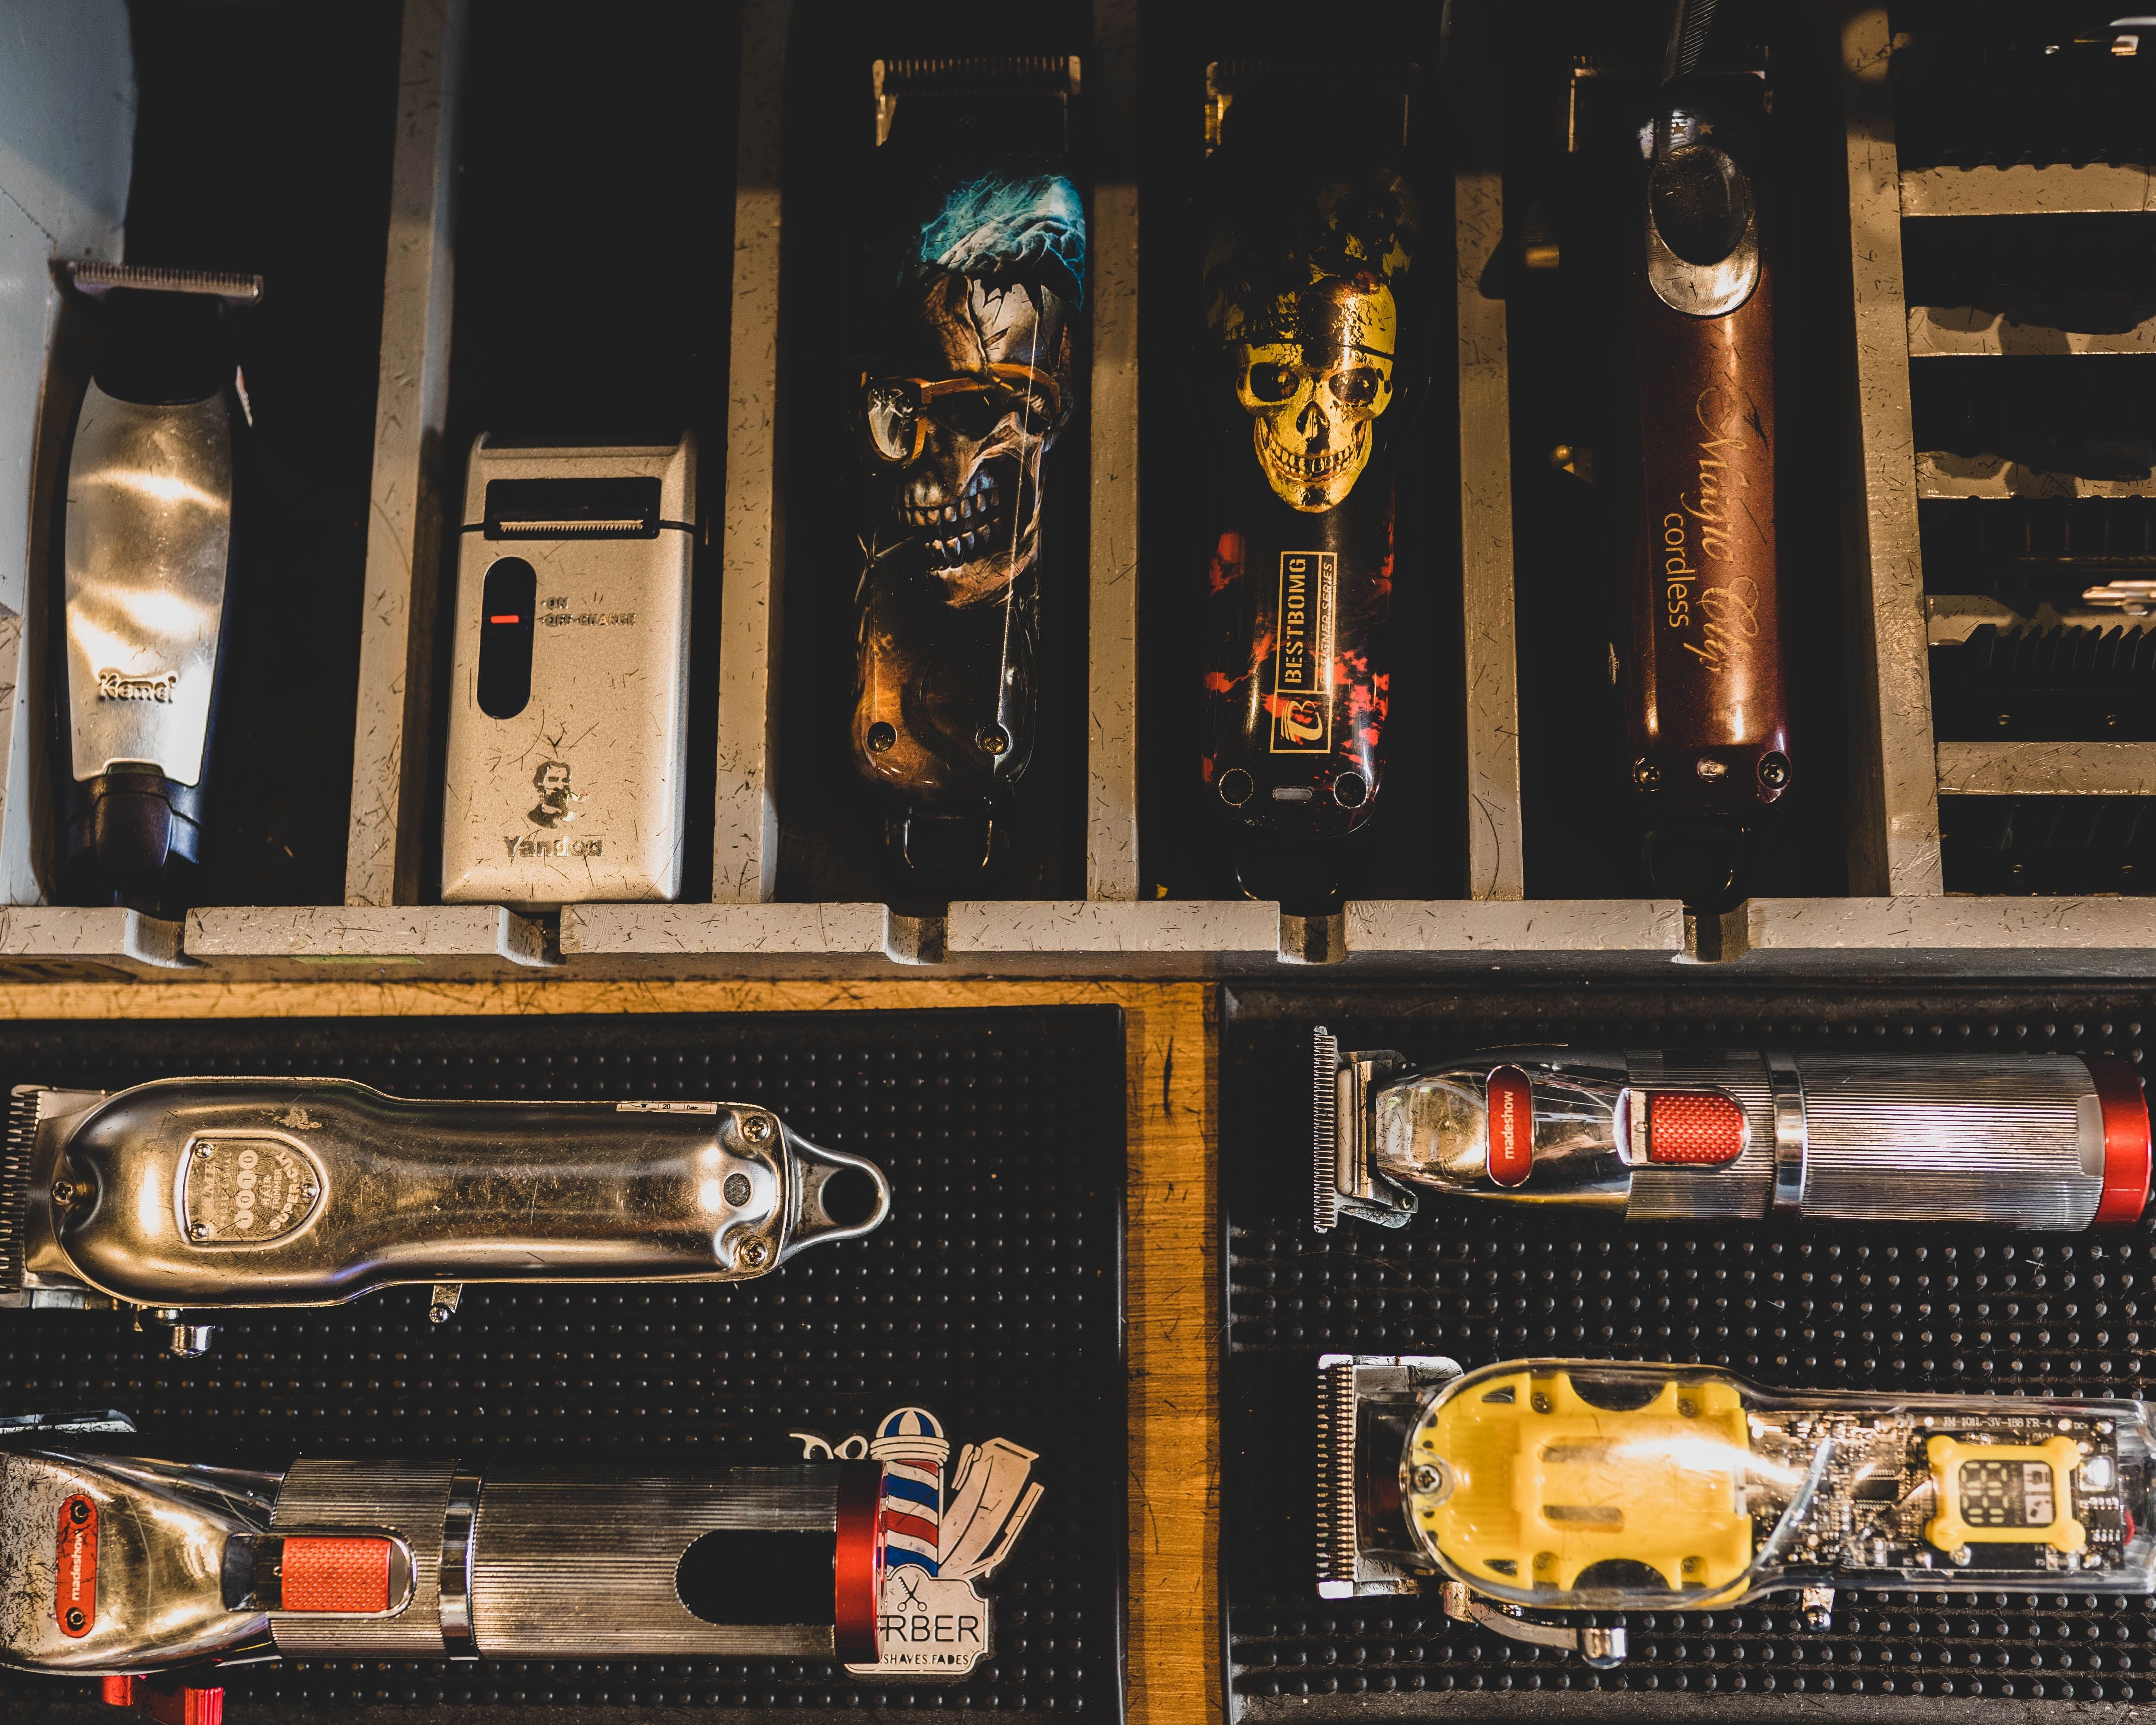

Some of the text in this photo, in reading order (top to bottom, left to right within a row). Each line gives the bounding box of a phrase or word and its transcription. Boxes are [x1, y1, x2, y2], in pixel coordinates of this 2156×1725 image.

[1680, 386, 1751, 563] Magic
[1322, 562, 1332, 609] SERIES
[1664, 513, 1695, 627] cordless
[1285, 559, 1306, 683] BESTBOMG
[98, 672, 177, 703] Kemei
[1501, 1091, 1514, 1160] madeshow
[260, 1175, 273, 1205] HAIR
[272, 1168, 282, 1210] TRIMMER
[71, 1531, 83, 1601] madeshow
[885, 1614, 980, 1643] RBER
